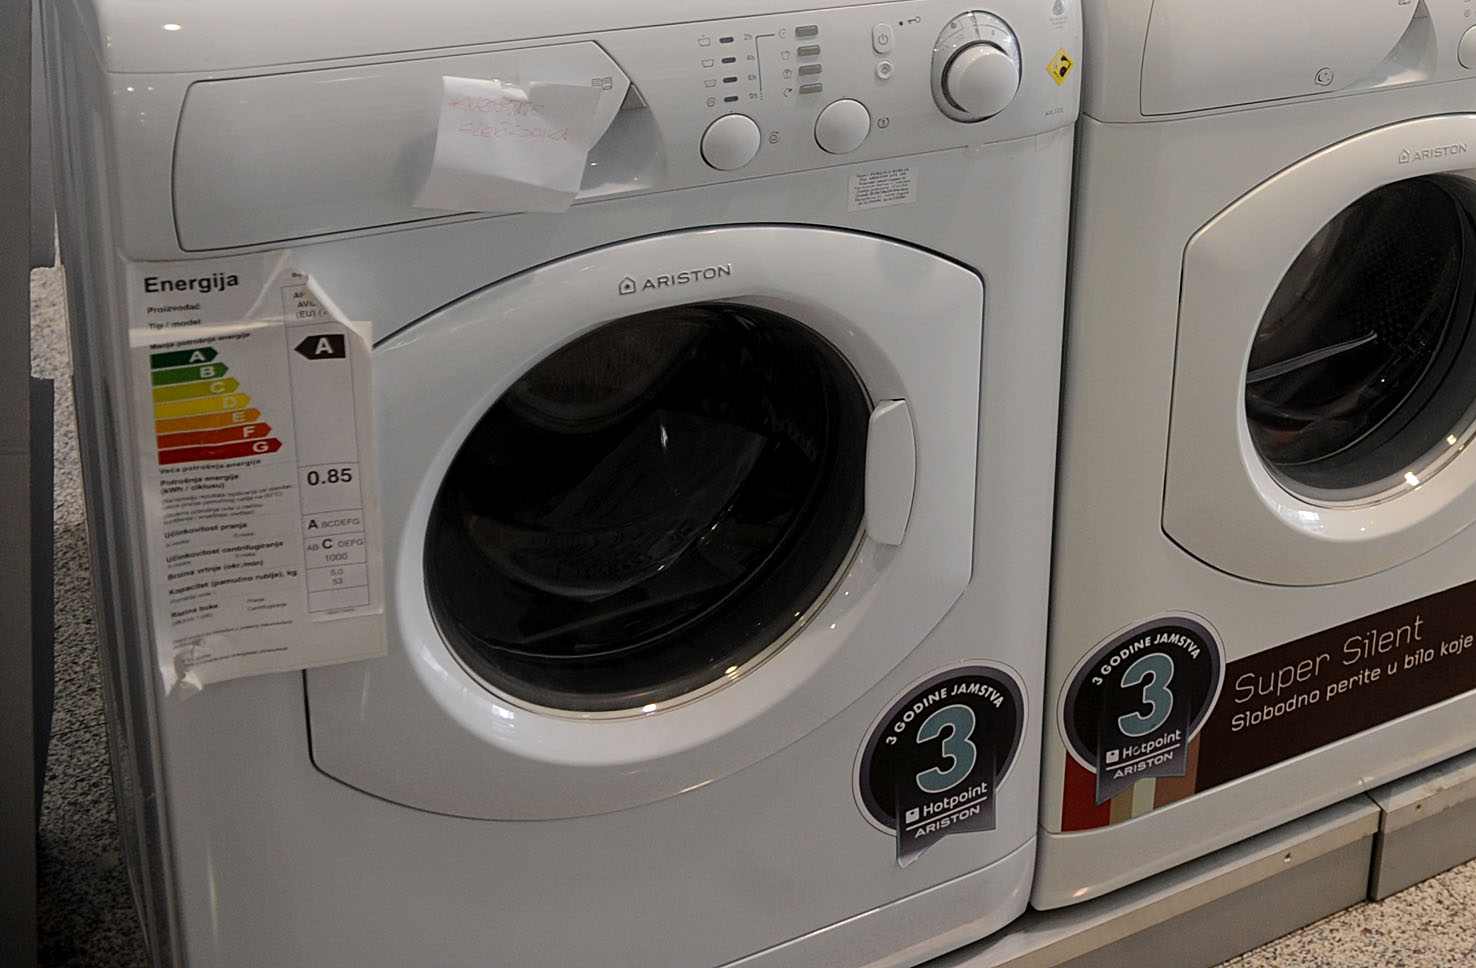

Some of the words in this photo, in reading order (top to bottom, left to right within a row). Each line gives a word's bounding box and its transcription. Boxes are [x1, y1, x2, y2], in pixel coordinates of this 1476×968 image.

[1412, 143, 1467, 161] ARISTON
[144, 272, 239, 294] Energija
[642, 264, 732, 291] ARISTON
[315, 337, 333, 355] A
[189, 350, 206, 363] A
[200, 366, 215, 378] B
[210, 382, 225, 394] C
[222, 397, 237, 410] D
[232, 411, 246, 423] E
[243, 426, 255, 438] F
[252, 440, 269, 453] G
[306, 468, 353, 486] 0.85
[307, 519, 319, 530] A
[321, 518, 360, 529] BCDEFG
[322, 538, 333, 549] C
[325, 553, 348, 562] 1000
[286, 569, 297, 577] kg
[1092, 677, 1103, 686] 3
[1101, 636, 1151, 675] GODINE
[1154, 633, 1201, 660] JAMSTVA
[1233, 653, 1331, 704] Super
[1342, 614, 1425, 666] Silent
[1231, 689, 1320, 732] Slobodno
[1326, 667, 1382, 702] perite
[1387, 662, 1398, 675] u
[1403, 648, 1435, 670] bilo
[1439, 633, 1474, 657] koje
[1117, 652, 1175, 738] 3
[886, 735, 897, 745] 3
[894, 688, 948, 733] GODINE
[951, 683, 1004, 708] JAMSTVA
[916, 704, 977, 794] 3
[1122, 729, 1182, 760] Hotpoint
[1113, 751, 1173, 780] ARISTON
[923, 782, 988, 817] Hotpoint
[915, 805, 980, 839] ARISTON
